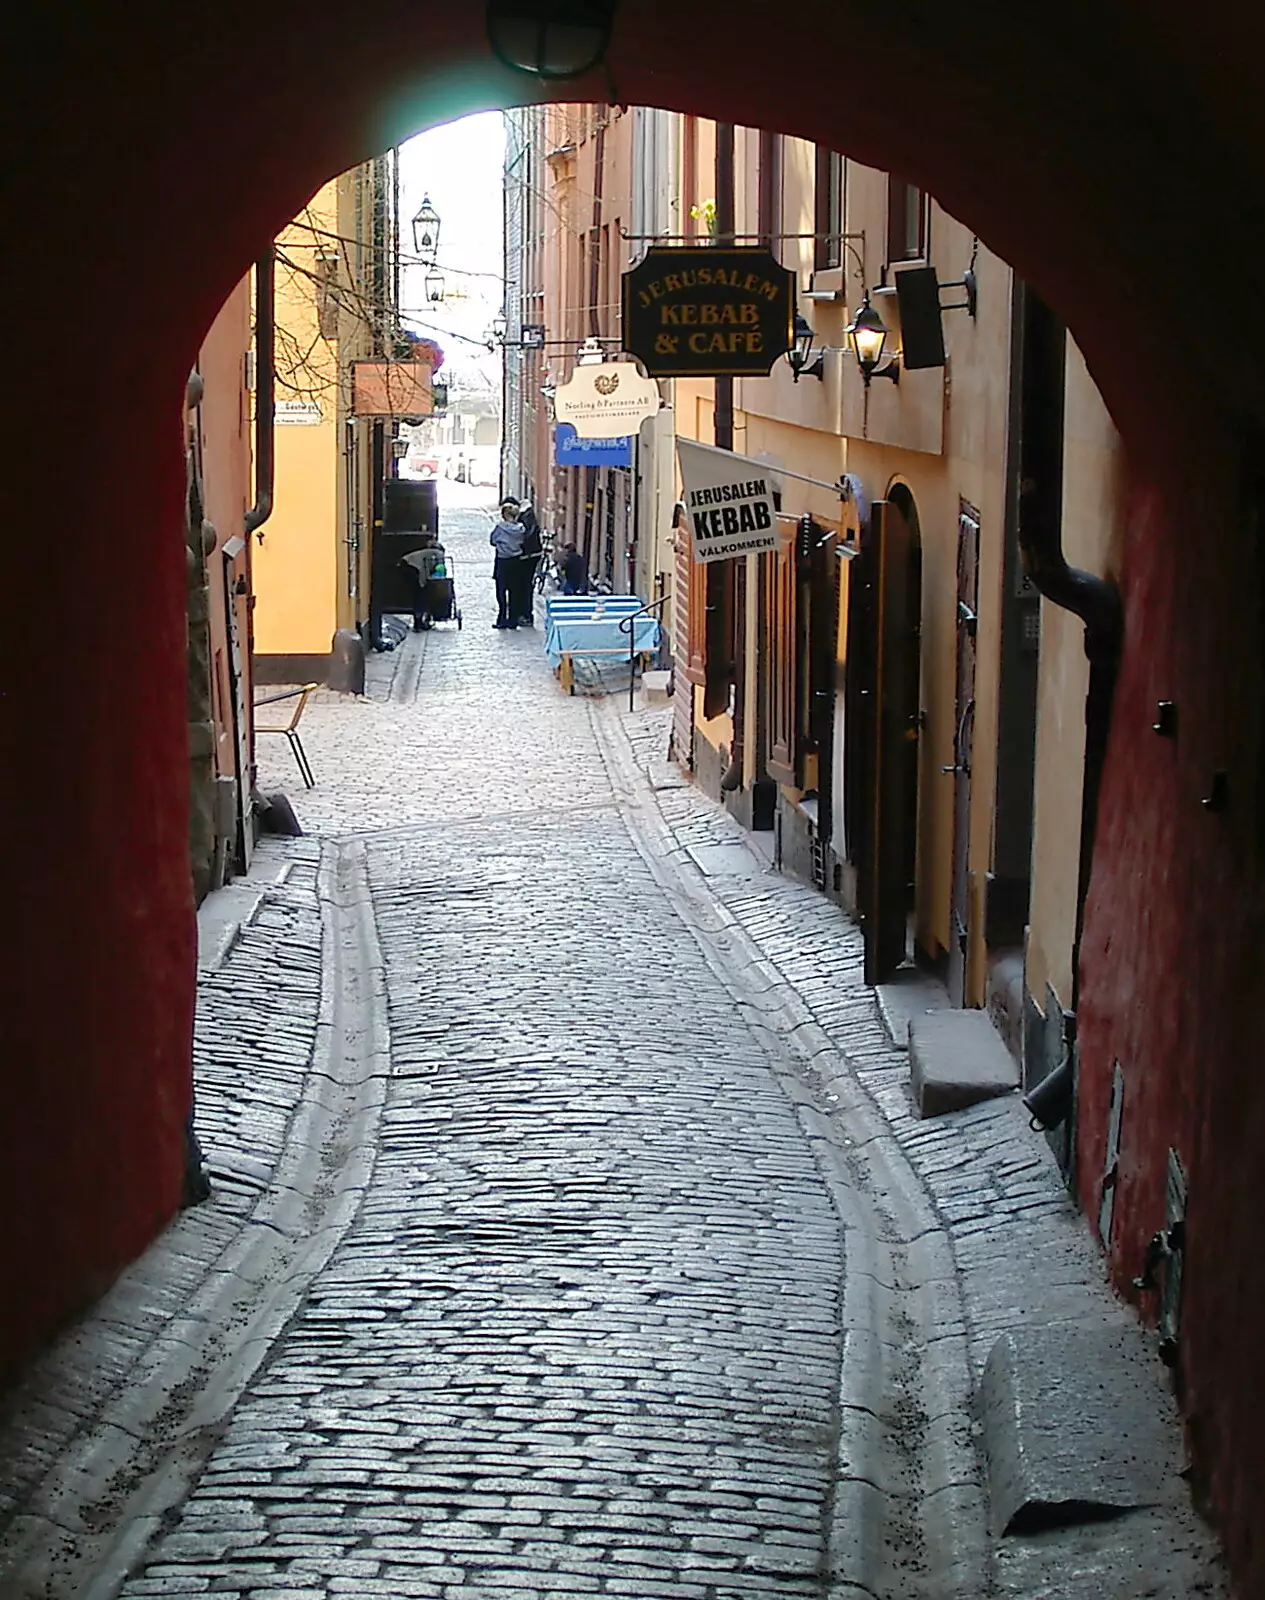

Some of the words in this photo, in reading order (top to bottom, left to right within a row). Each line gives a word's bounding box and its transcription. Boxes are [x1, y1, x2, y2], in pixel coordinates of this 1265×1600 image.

[638, 268, 780, 308] JERUSALEM
[661, 304, 760, 325] KEBAB
[655, 334, 679, 354] &
[688, 325, 764, 353] CAFÉ
[691, 480, 767, 507] JERUSALEM
[693, 502, 771, 541] KEBAB
